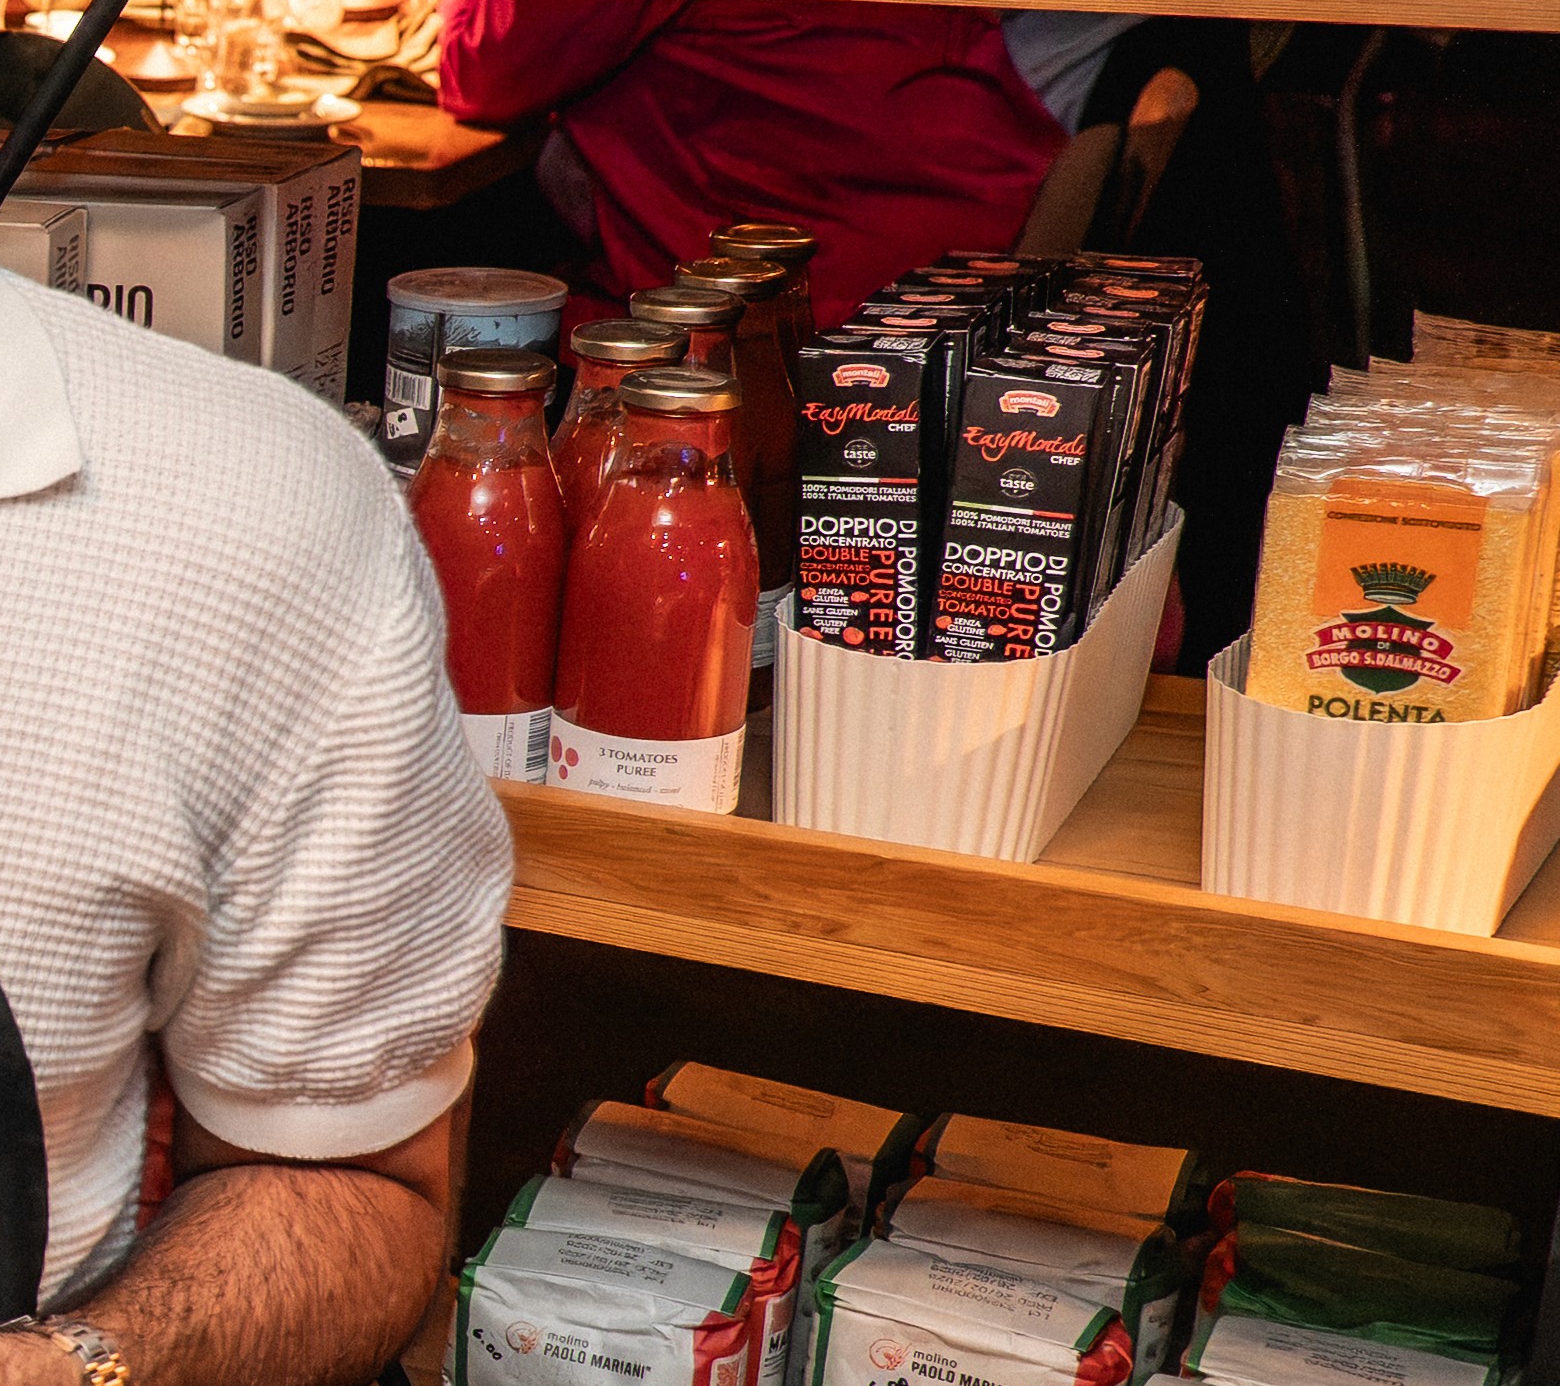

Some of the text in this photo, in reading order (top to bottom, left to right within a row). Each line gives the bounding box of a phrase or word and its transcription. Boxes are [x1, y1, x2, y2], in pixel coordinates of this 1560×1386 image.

[340, 177, 356, 236] RISO
[299, 196, 313, 256] RISO
[245, 214, 258, 277] RISO
[281, 203, 299, 317] ARBORIO
[231, 224, 246, 340] ARBORIO
[844, 450, 876, 459] taste
[1050, 456, 1081, 466] CHEF
[999, 478, 1035, 491] taste
[800, 516, 898, 537] DOPPIO
[898, 520, 917, 538] DI
[980, 514, 1030, 526] POMODORI
[800, 536, 897, 548] CONCENTRATO
[1017, 524, 1070, 539] TOMATOES
[801, 547, 870, 561] DOUBLE
[944, 542, 1046, 572] DOPPIO
[800, 571, 870, 585] TOMATO
[942, 562, 1042, 584] CONCENTRATO
[941, 573, 1014, 595] DOUBLE
[938, 598, 1010, 619] TOMATO
[1034, 556, 1068, 657] DI POMOD
[947, 624, 985, 636] GLUTINE
[1331, 625, 1440, 651] MOLINO
[1312, 651, 1452, 679] BORGO S.DALMAZZO
[1307, 695, 1446, 723] POLENTA
[599, 747, 678, 764] 3 TOMATOES
[616, 764, 657, 777] PUREE
[472, 1328, 503, 1361] 6.00
[547, 1332, 590, 1348] molino
[543, 1342, 646, 1380] PAOLO MARIANI
[913, 1350, 958, 1369] molino
[911, 1361, 955, 1384] PAOLO
